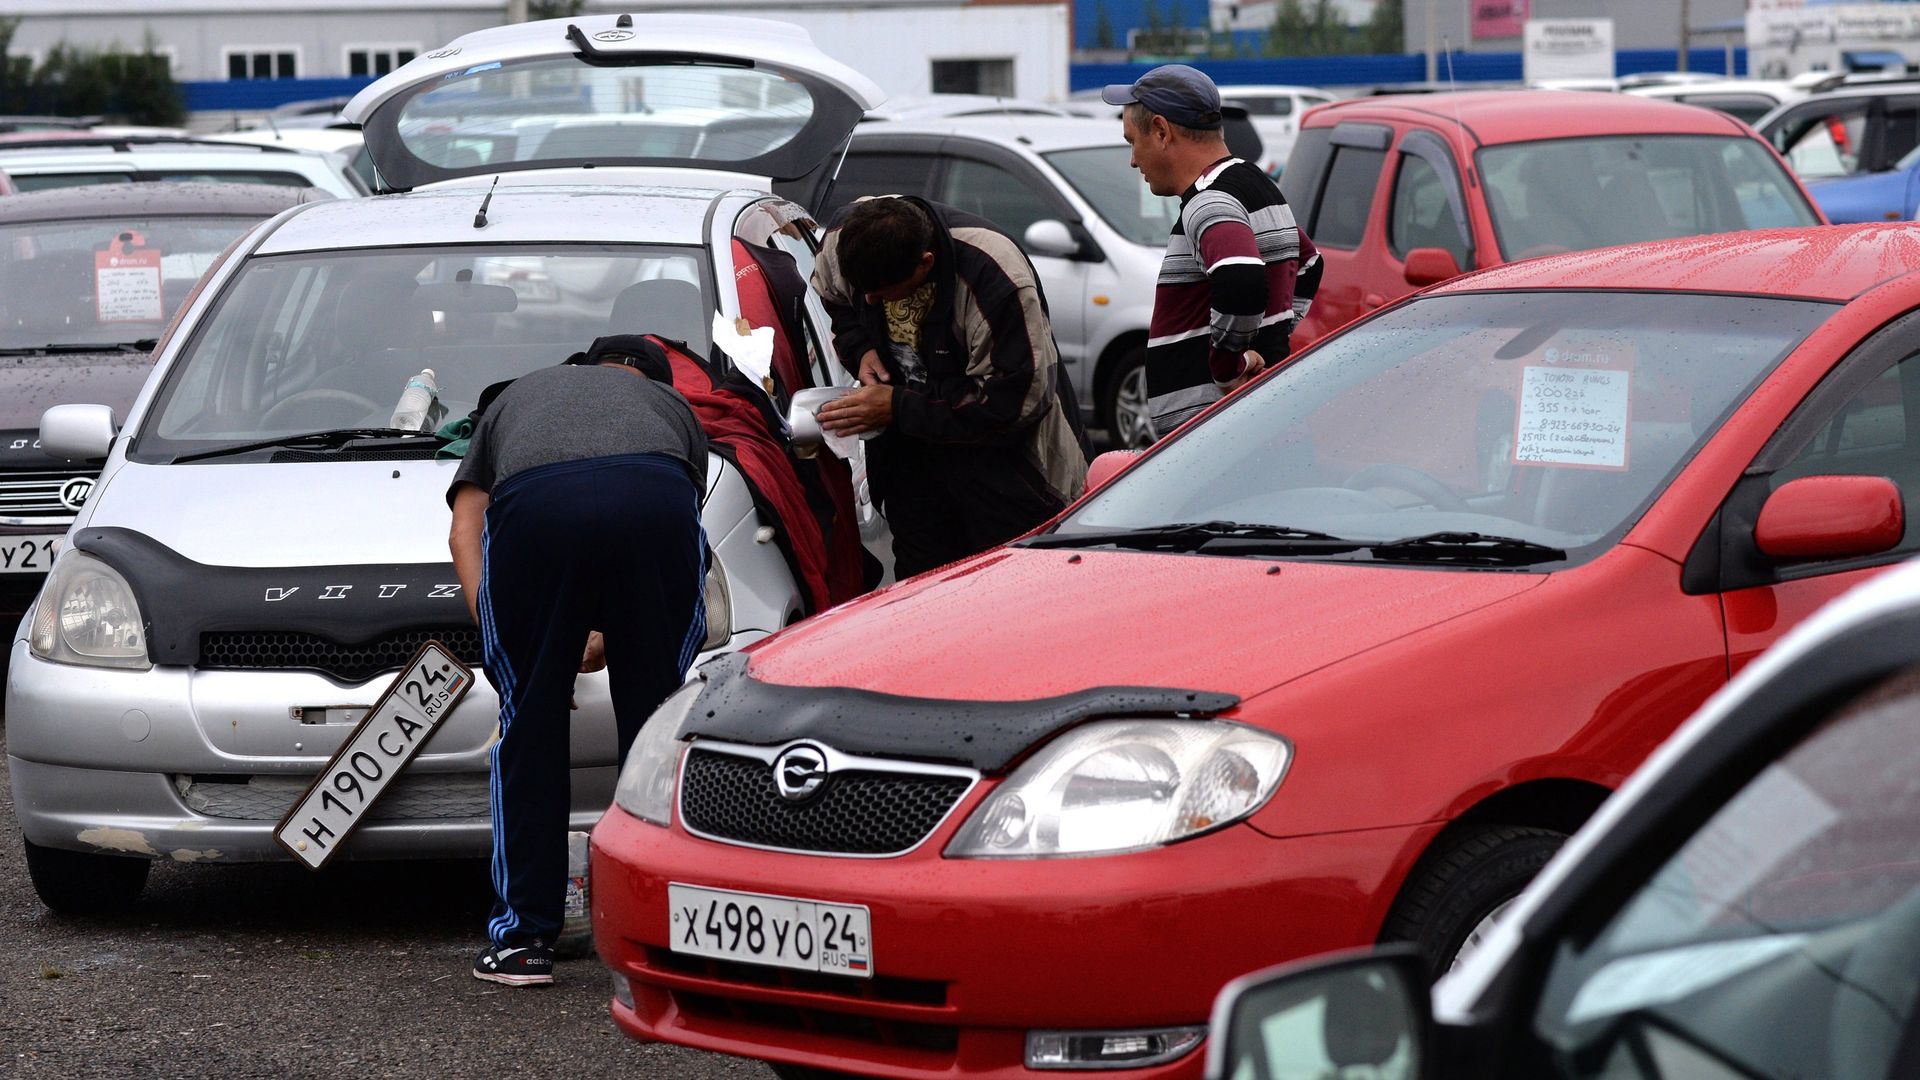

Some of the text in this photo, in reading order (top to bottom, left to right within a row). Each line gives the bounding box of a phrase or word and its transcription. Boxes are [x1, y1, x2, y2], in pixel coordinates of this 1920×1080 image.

[1538, 402, 1560, 413] 355
[265, 584, 462, 602] VITZ
[425, 691, 449, 718] RUS
[302, 664, 446, 849] Н190СА 24
[683, 900, 857, 961] Х498УО 24
[822, 951, 848, 968] RUS
